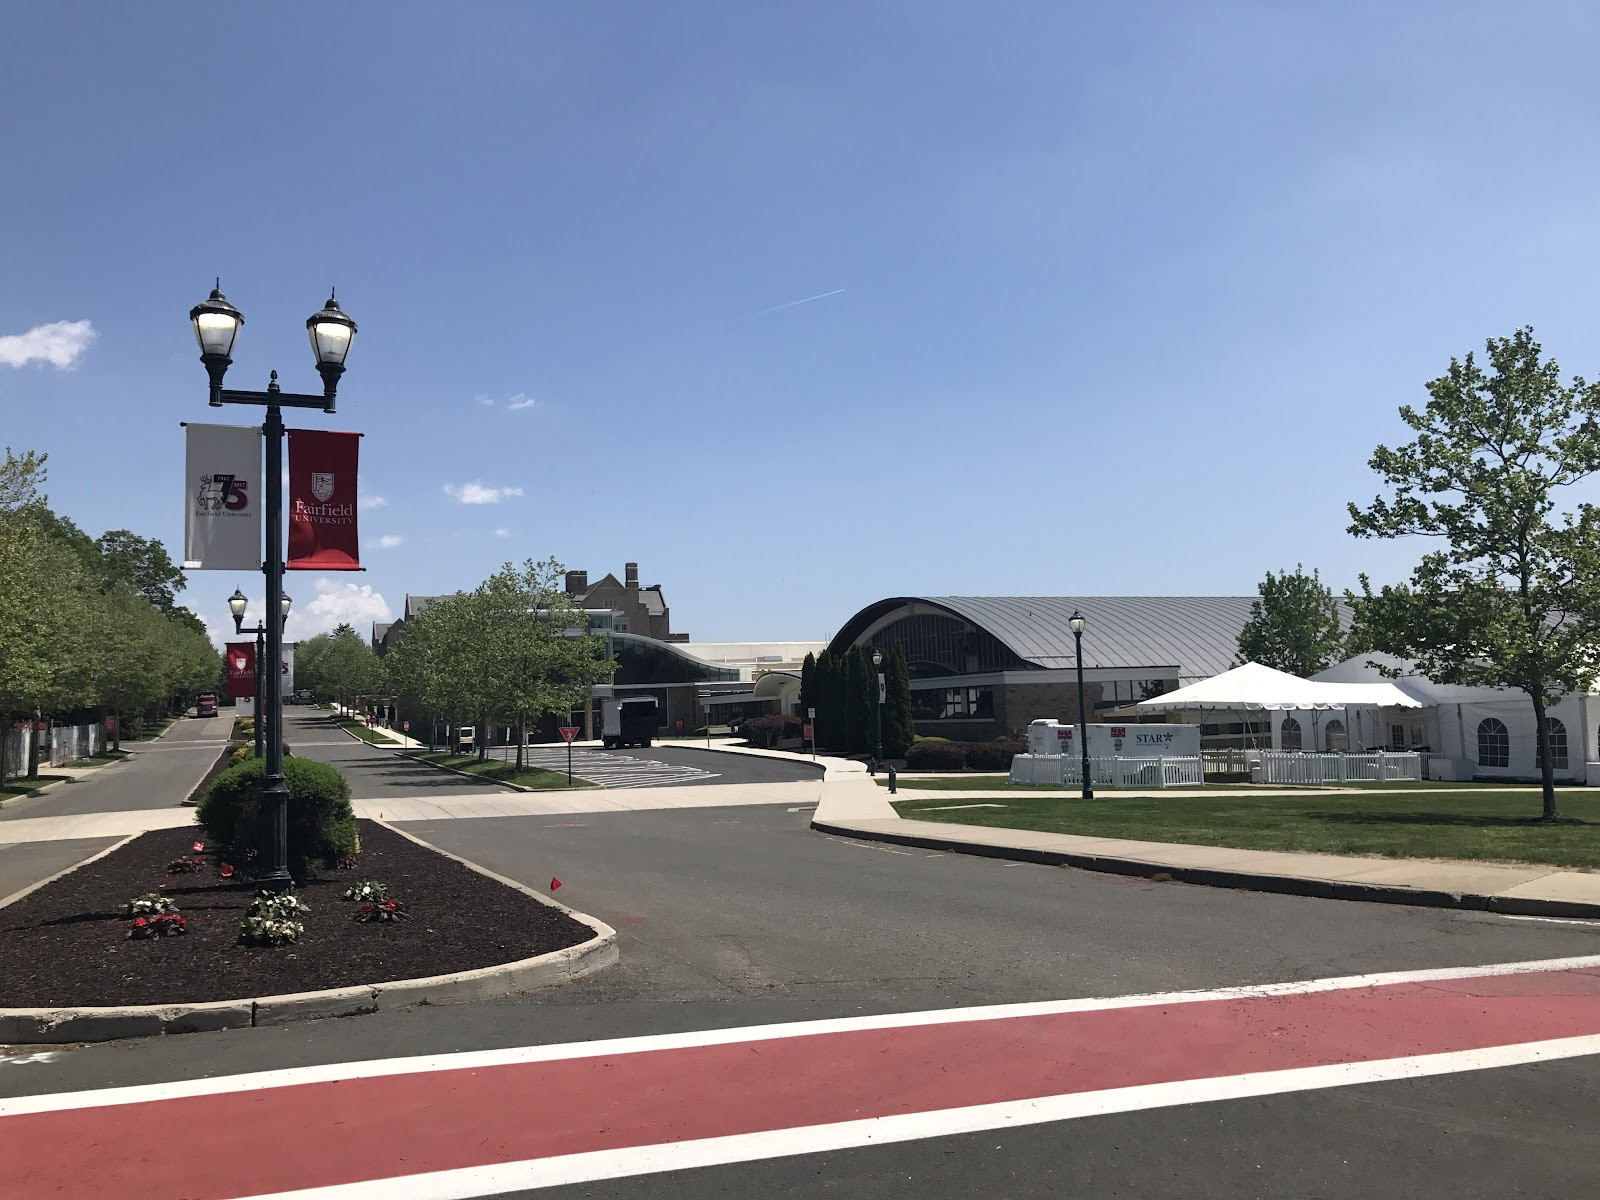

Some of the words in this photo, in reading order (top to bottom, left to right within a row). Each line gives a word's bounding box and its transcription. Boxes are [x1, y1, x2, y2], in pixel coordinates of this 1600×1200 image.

[214, 474, 248, 511] 75
[296, 500, 354, 516] Fairfield
[295, 514, 354, 525] UNIVERSITY
[1136, 733, 1163, 743] STAR
